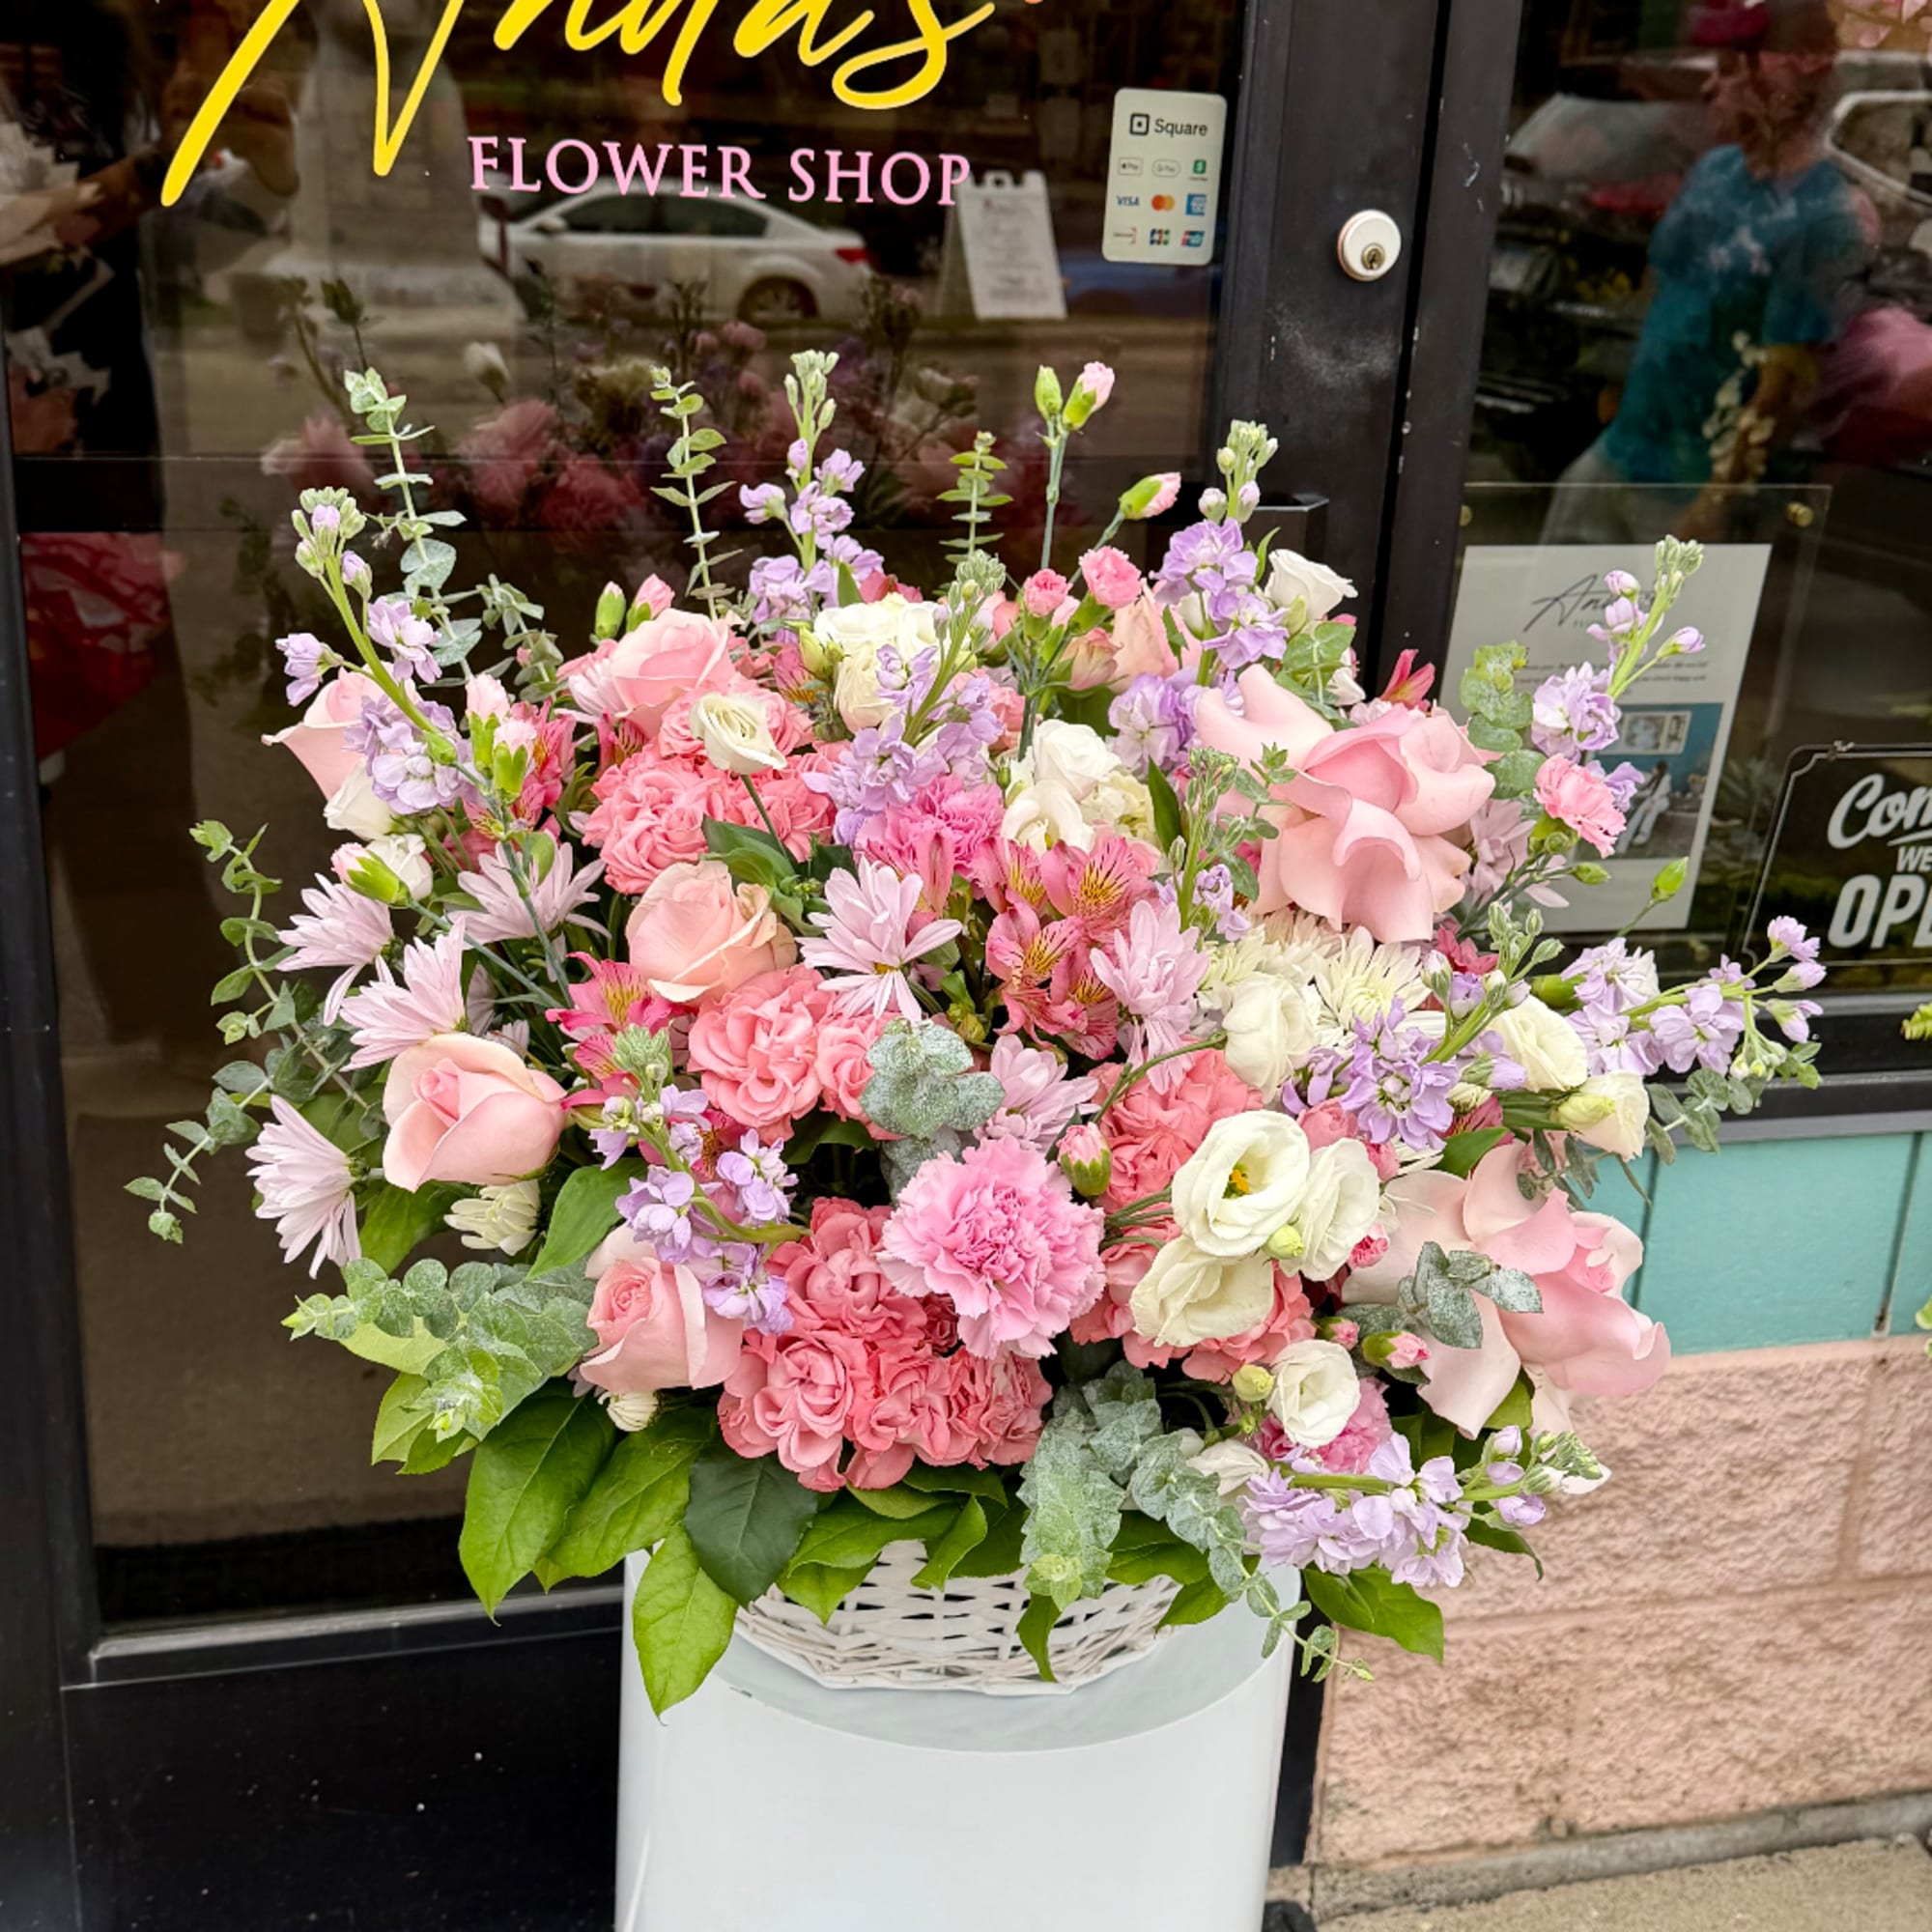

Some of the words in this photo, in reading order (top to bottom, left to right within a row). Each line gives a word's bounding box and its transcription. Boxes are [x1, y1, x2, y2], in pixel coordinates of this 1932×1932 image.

[1153, 117, 1208, 138] Square
[468, 135, 766, 200] FLOWER
[788, 148, 971, 207] SHOP
[1116, 195, 1140, 207] VISA
